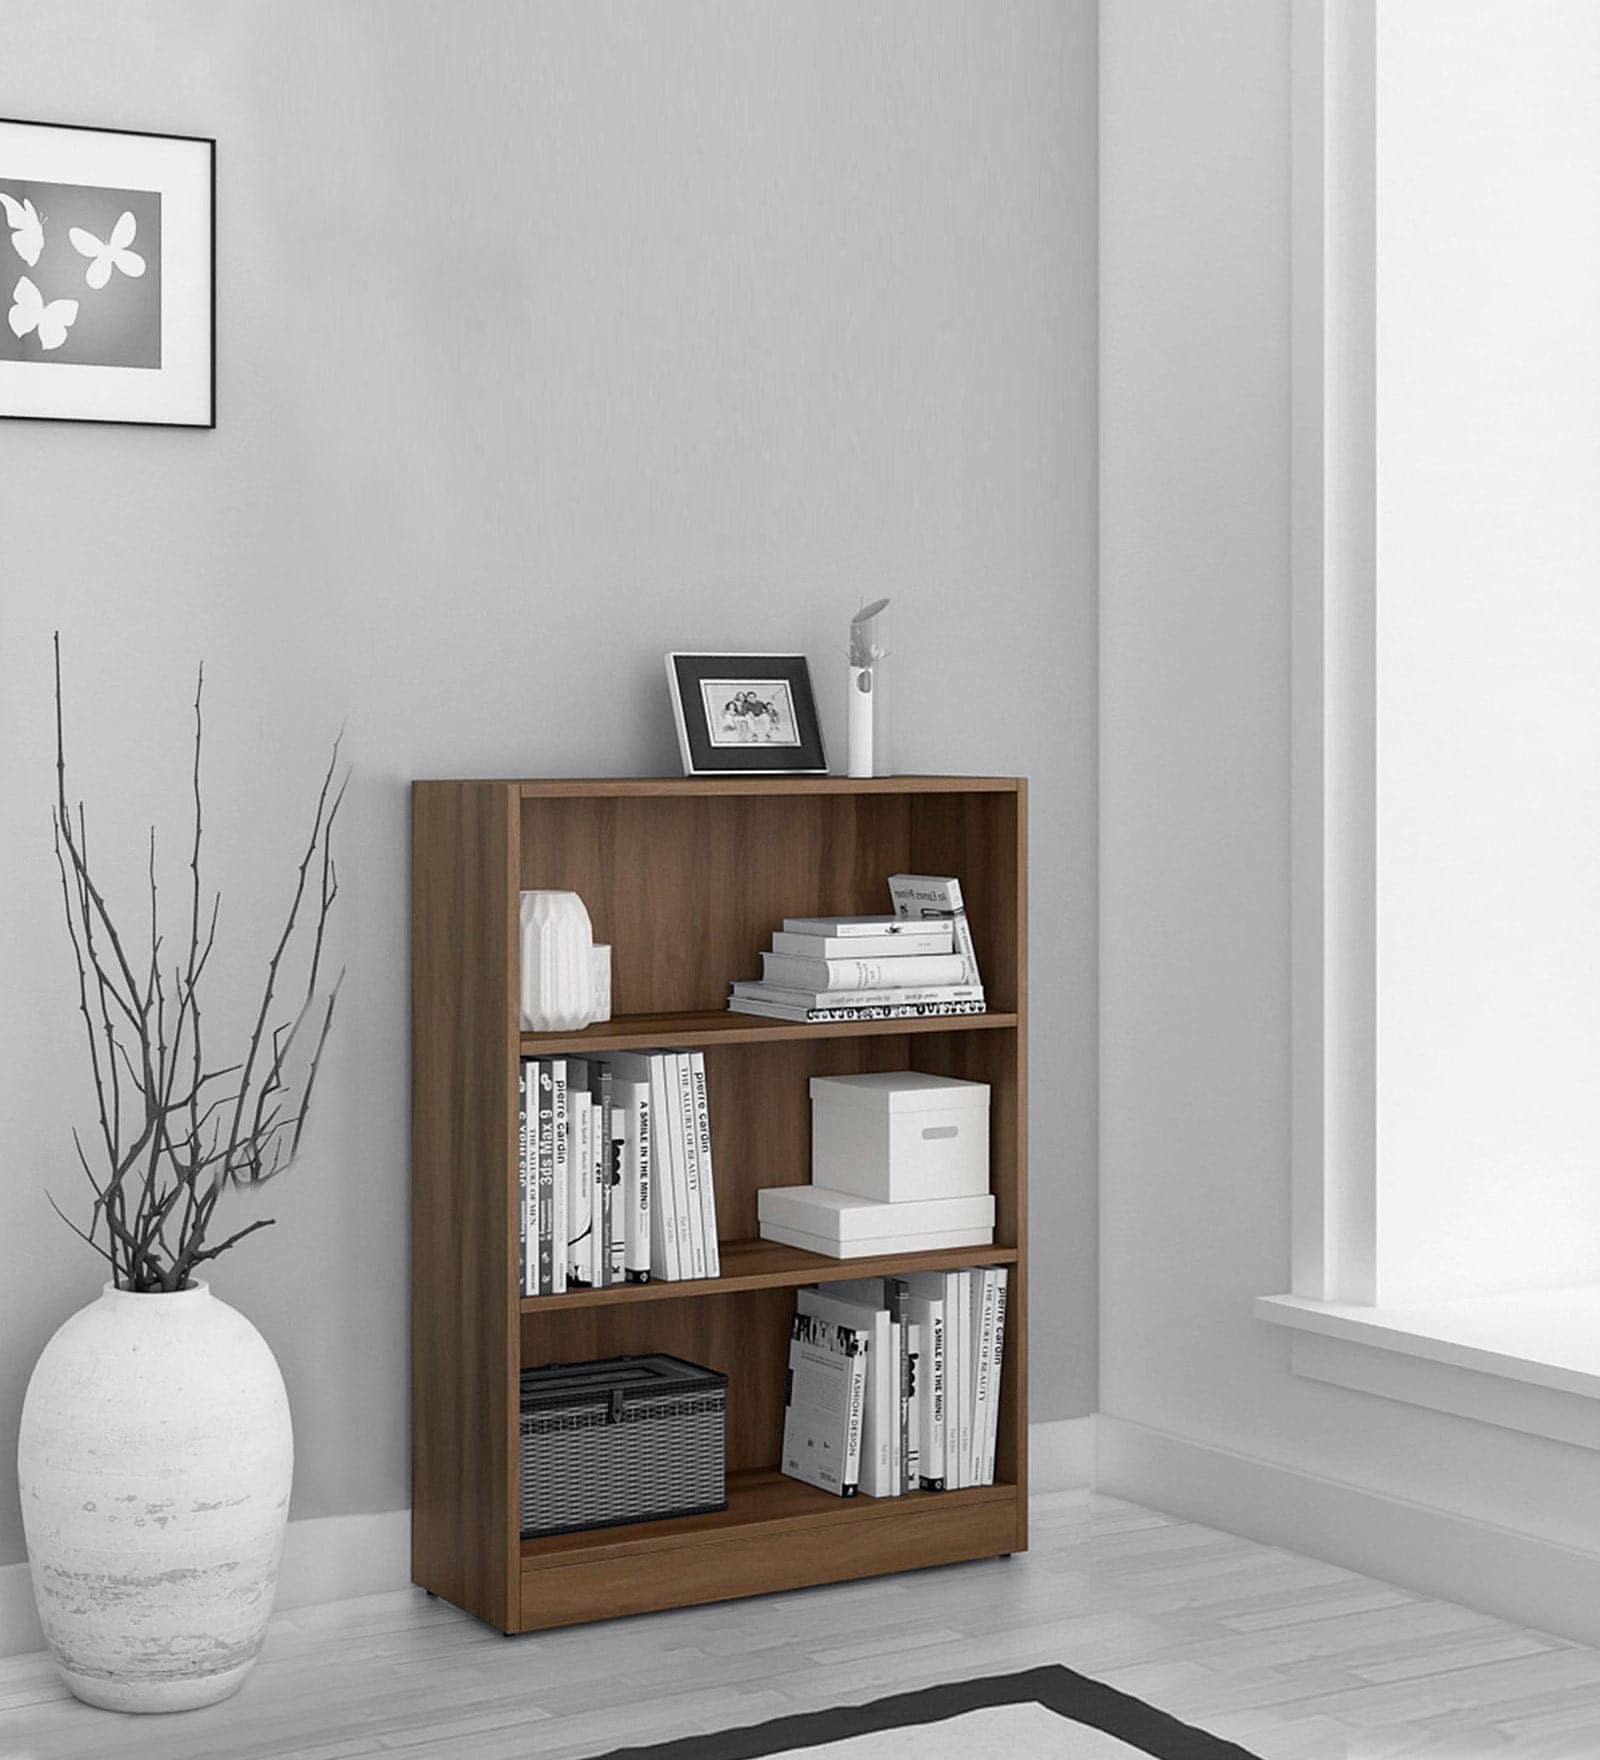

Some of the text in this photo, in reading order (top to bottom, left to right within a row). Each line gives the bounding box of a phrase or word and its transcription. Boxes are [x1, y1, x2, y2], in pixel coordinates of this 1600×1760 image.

[540, 1110, 552, 1118] 9
[556, 1080, 566, 1164] pierre cardin
[640, 1112, 648, 1142] SMILE
[694, 1072, 710, 1153] pierre cardin
[540, 1123, 552, 1154] Max
[681, 1068, 697, 1192] THE ALLURE OF BEAUTY
[640, 1147, 648, 1157] IN
[540, 1159, 552, 1185] 3ds
[640, 1161, 648, 1179] THE
[640, 1182, 648, 1210] MIND
[983, 1306, 992, 1344] ALLURE
[994, 1287, 1006, 1365] pierre cardin
[935, 1361, 942, 1371] IN
[982, 1346, 989, 1358] OF
[979, 1362, 988, 1401] BEAUTY
[849, 1373, 862, 1456] FASHION DESIGN
